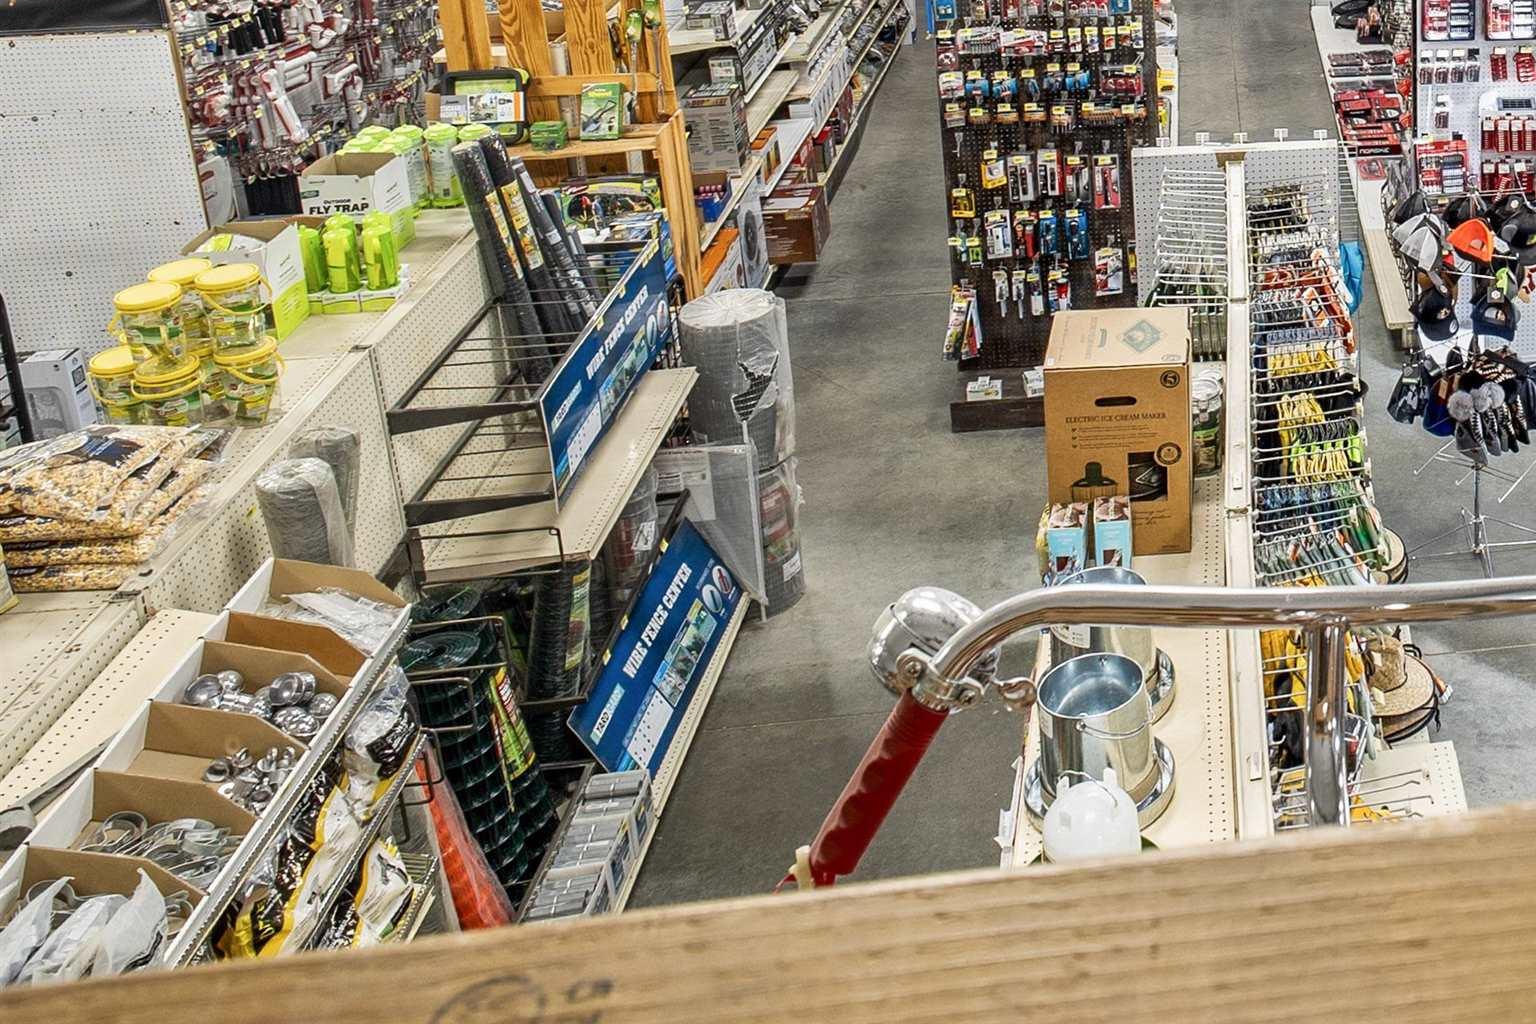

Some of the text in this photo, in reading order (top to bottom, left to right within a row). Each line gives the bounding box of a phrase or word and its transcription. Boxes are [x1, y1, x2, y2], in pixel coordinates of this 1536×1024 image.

[309, 202, 369, 215] FLY TRAP
[1065, 415, 1099, 424] ELECTRIC
[1114, 413, 1139, 421] CREAM
[622, 562, 693, 679] WIRE FENCE CENTER
